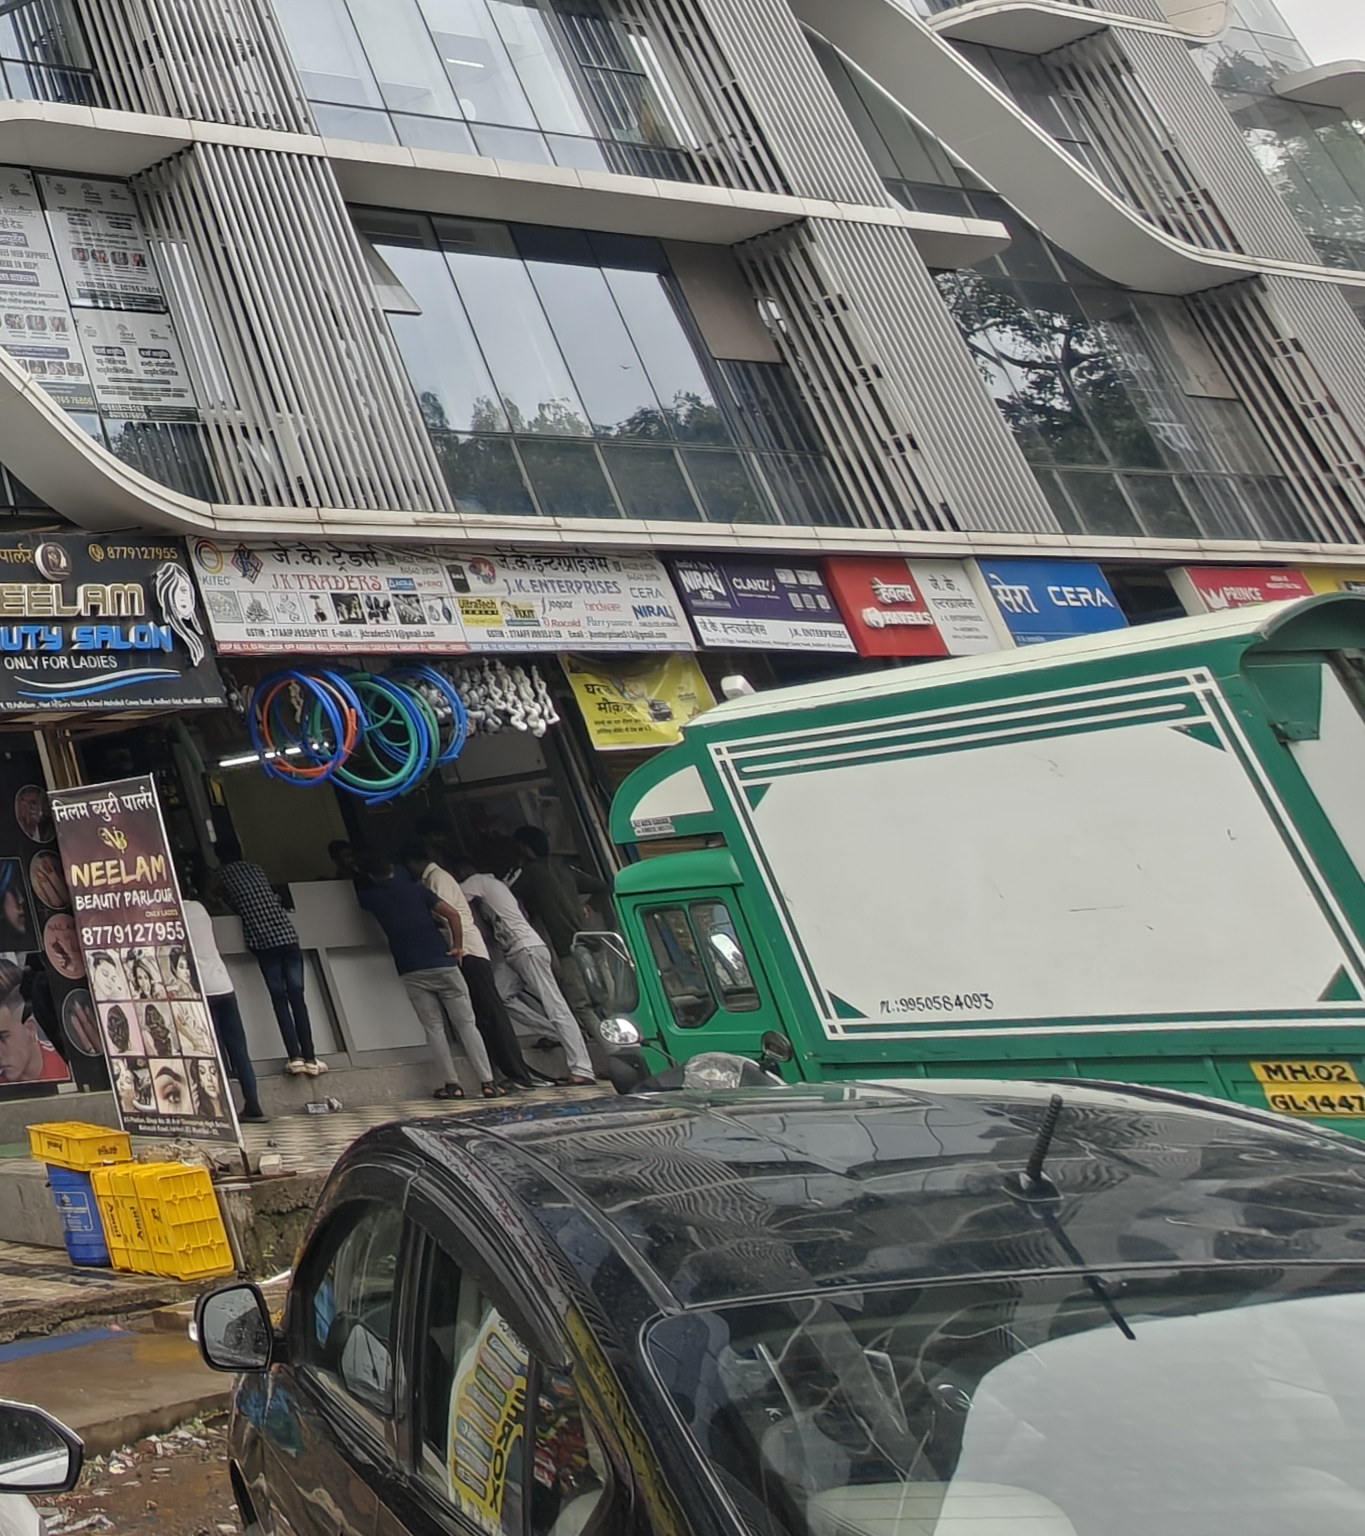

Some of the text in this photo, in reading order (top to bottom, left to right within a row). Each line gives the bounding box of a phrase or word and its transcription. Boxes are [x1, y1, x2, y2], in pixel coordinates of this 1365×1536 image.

[988, 572, 1040, 615] सेरा
[1046, 584, 1115, 609] CERA
[1222, 586, 1264, 602] PRINCE
[71, 621, 174, 653] SALON
[4, 654, 119, 671] ONLY FOR LADIES
[51, 799, 90, 823] निलम
[70, 853, 168, 888] NEELAM
[75, 887, 177, 912] BEAUTY PARLOUR
[81, 920, 186, 946] 8779127955
